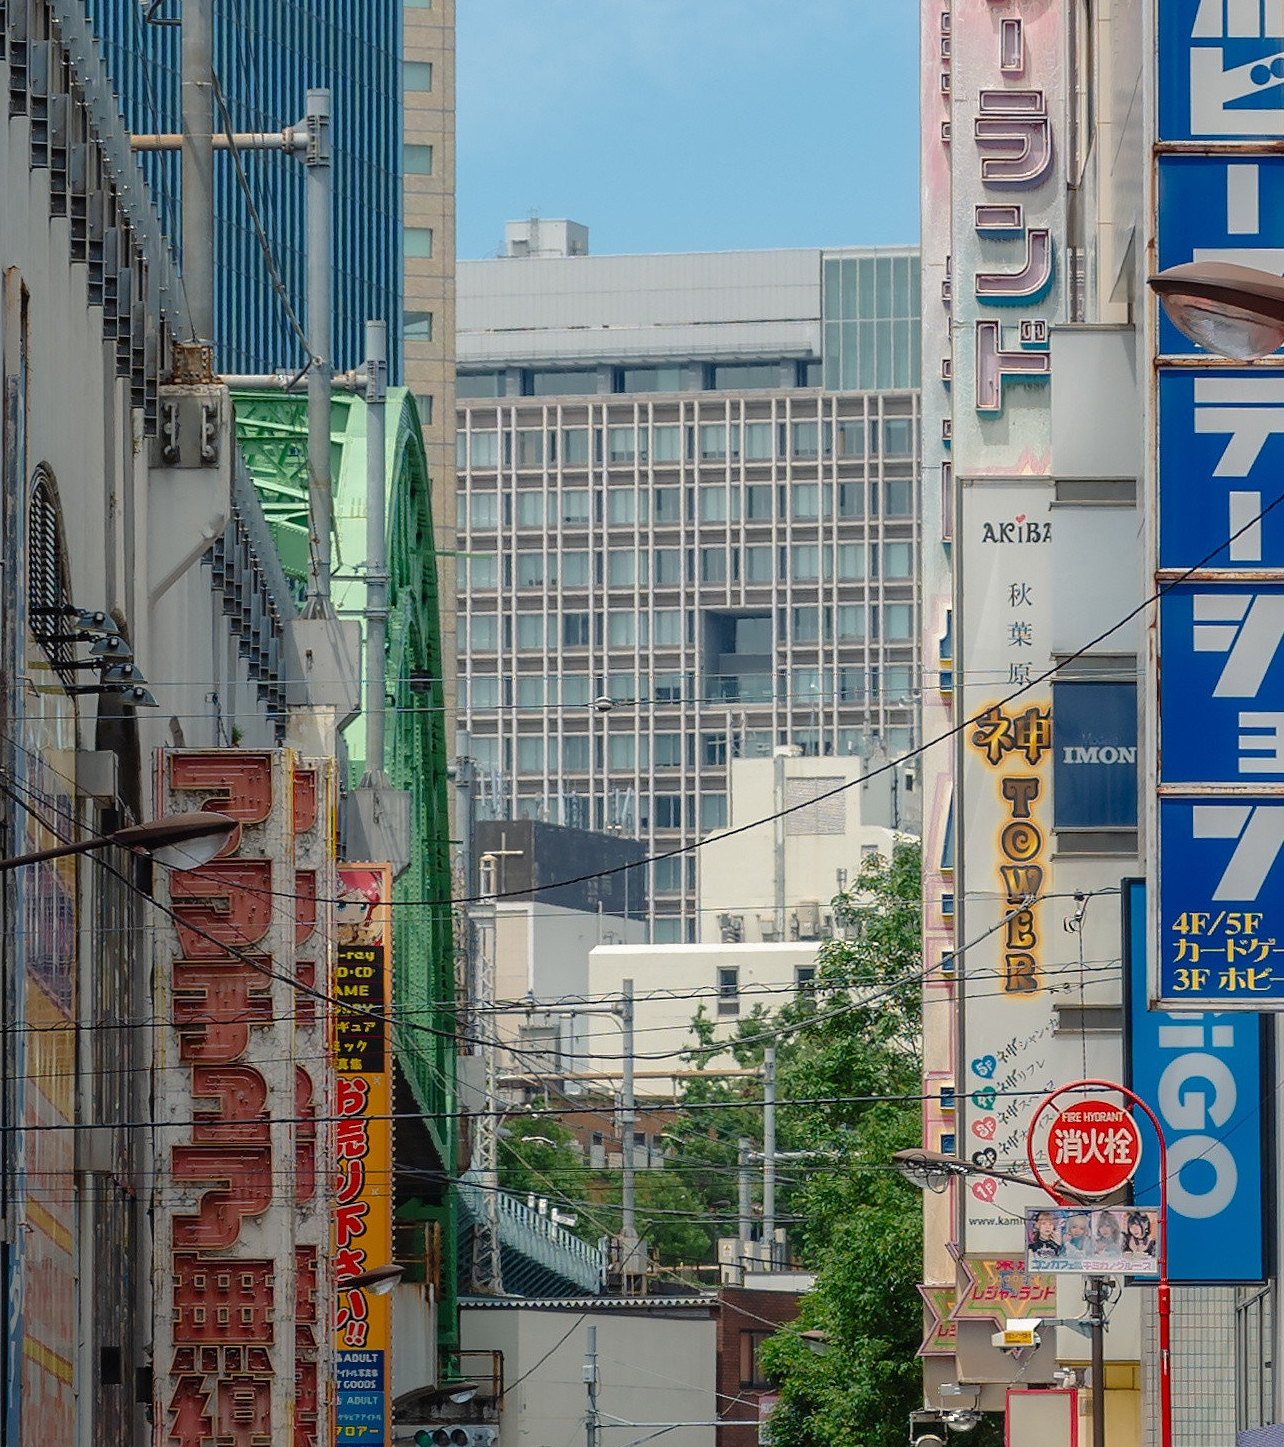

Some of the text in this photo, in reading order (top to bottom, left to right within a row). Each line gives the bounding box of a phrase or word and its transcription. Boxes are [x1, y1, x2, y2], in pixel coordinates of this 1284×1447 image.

[1007, 581, 1034, 687] 秋葉原
[1062, 746, 1138, 765] IMON
[999, 776, 1044, 994] TOWER
[1172, 911, 1264, 937] 4F/5F
[1171, 968, 1210, 992] 3F
[1061, 1111, 1124, 1123] FIRE HYDRANT
[1158, 1012, 1239, 1219] iGO
[1054, 1127, 1134, 1166] 消火栓
